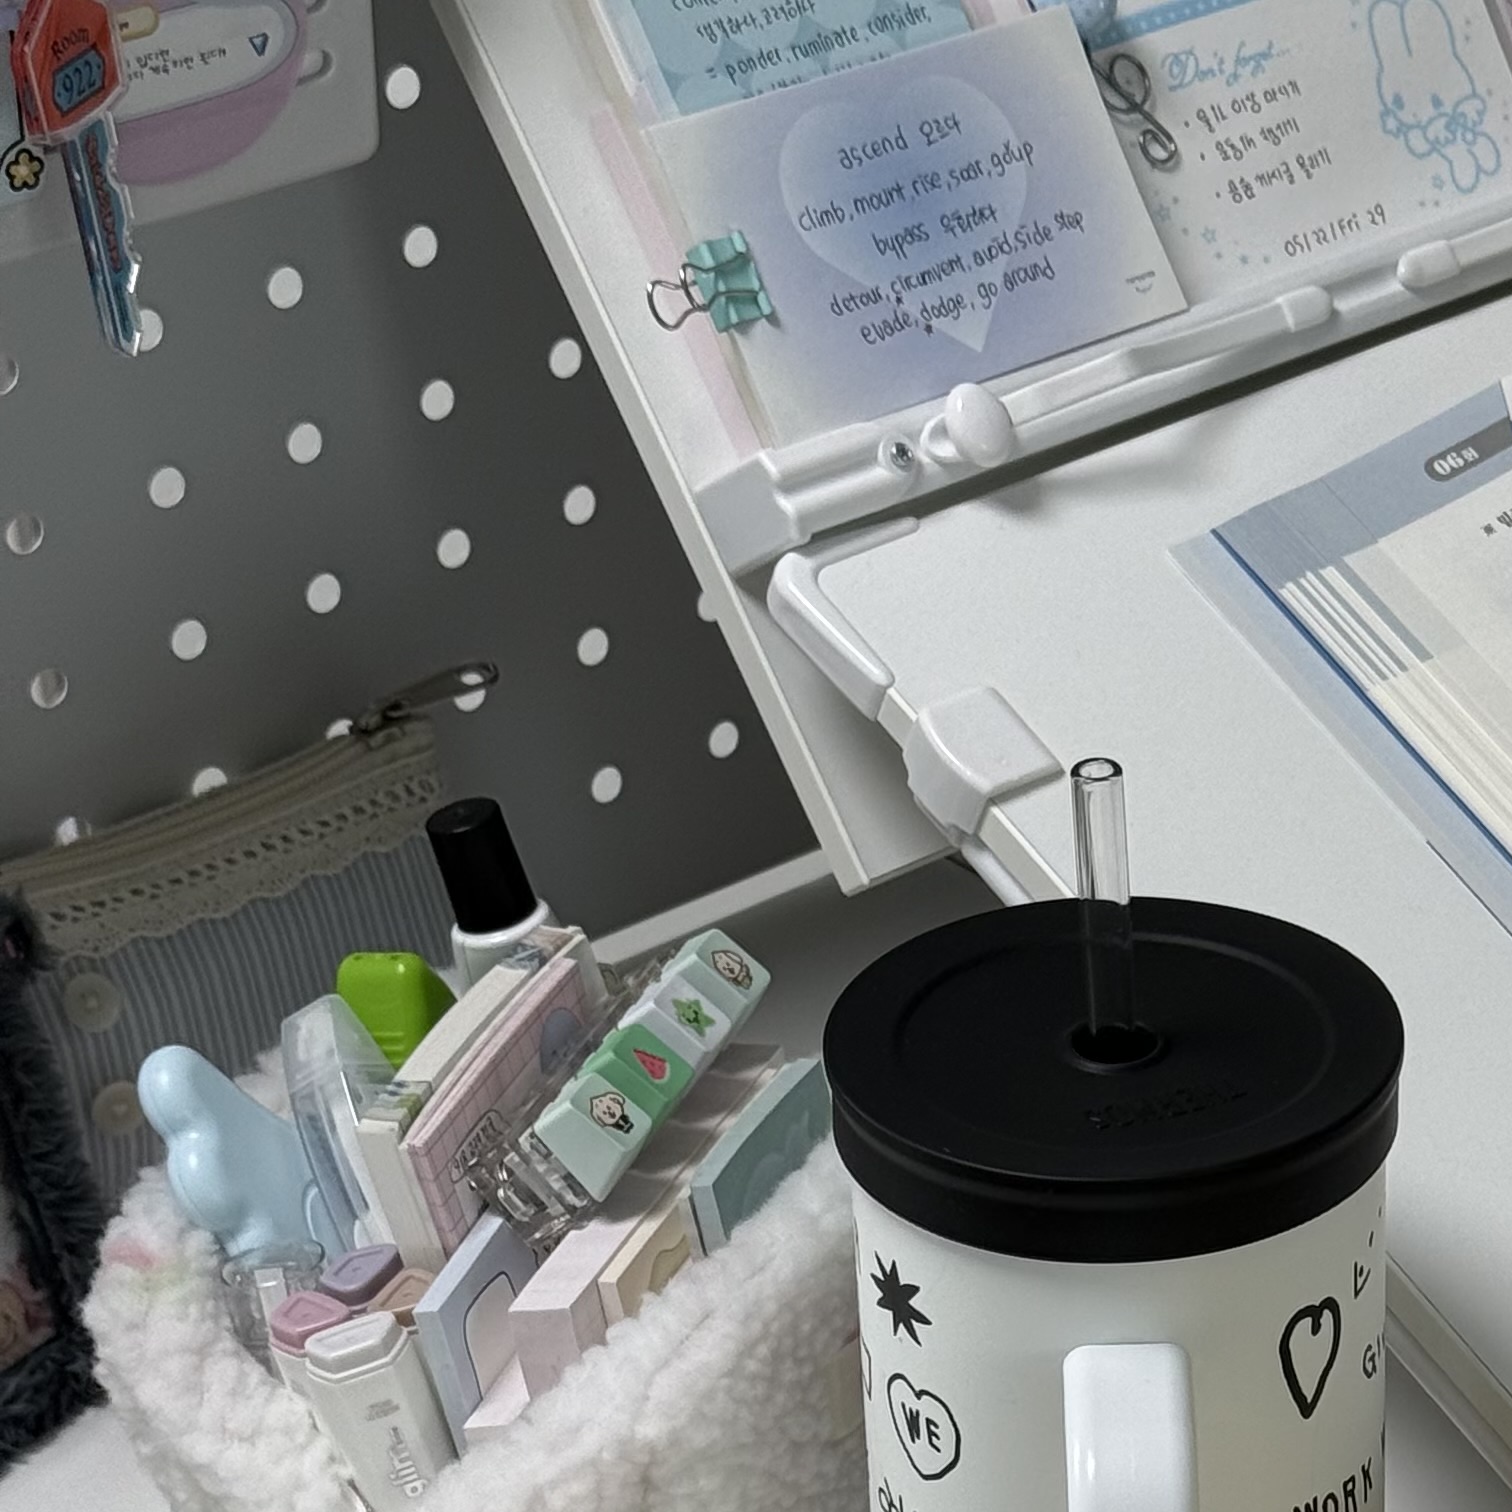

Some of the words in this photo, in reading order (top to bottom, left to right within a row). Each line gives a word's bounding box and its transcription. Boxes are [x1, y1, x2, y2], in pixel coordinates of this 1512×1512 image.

[867, 4, 932, 37] consider,
[61, 58, 97, 105] 922
[1231, 88, 1264, 114] 이상
[838, 124, 909, 171] ascend
[872, 222, 930, 261] bypass
[1054, 208, 1086, 237] step
[976, 282, 1000, 311] go
[1002, 256, 1056, 294] around
[901, 1401, 942, 1454] WE
